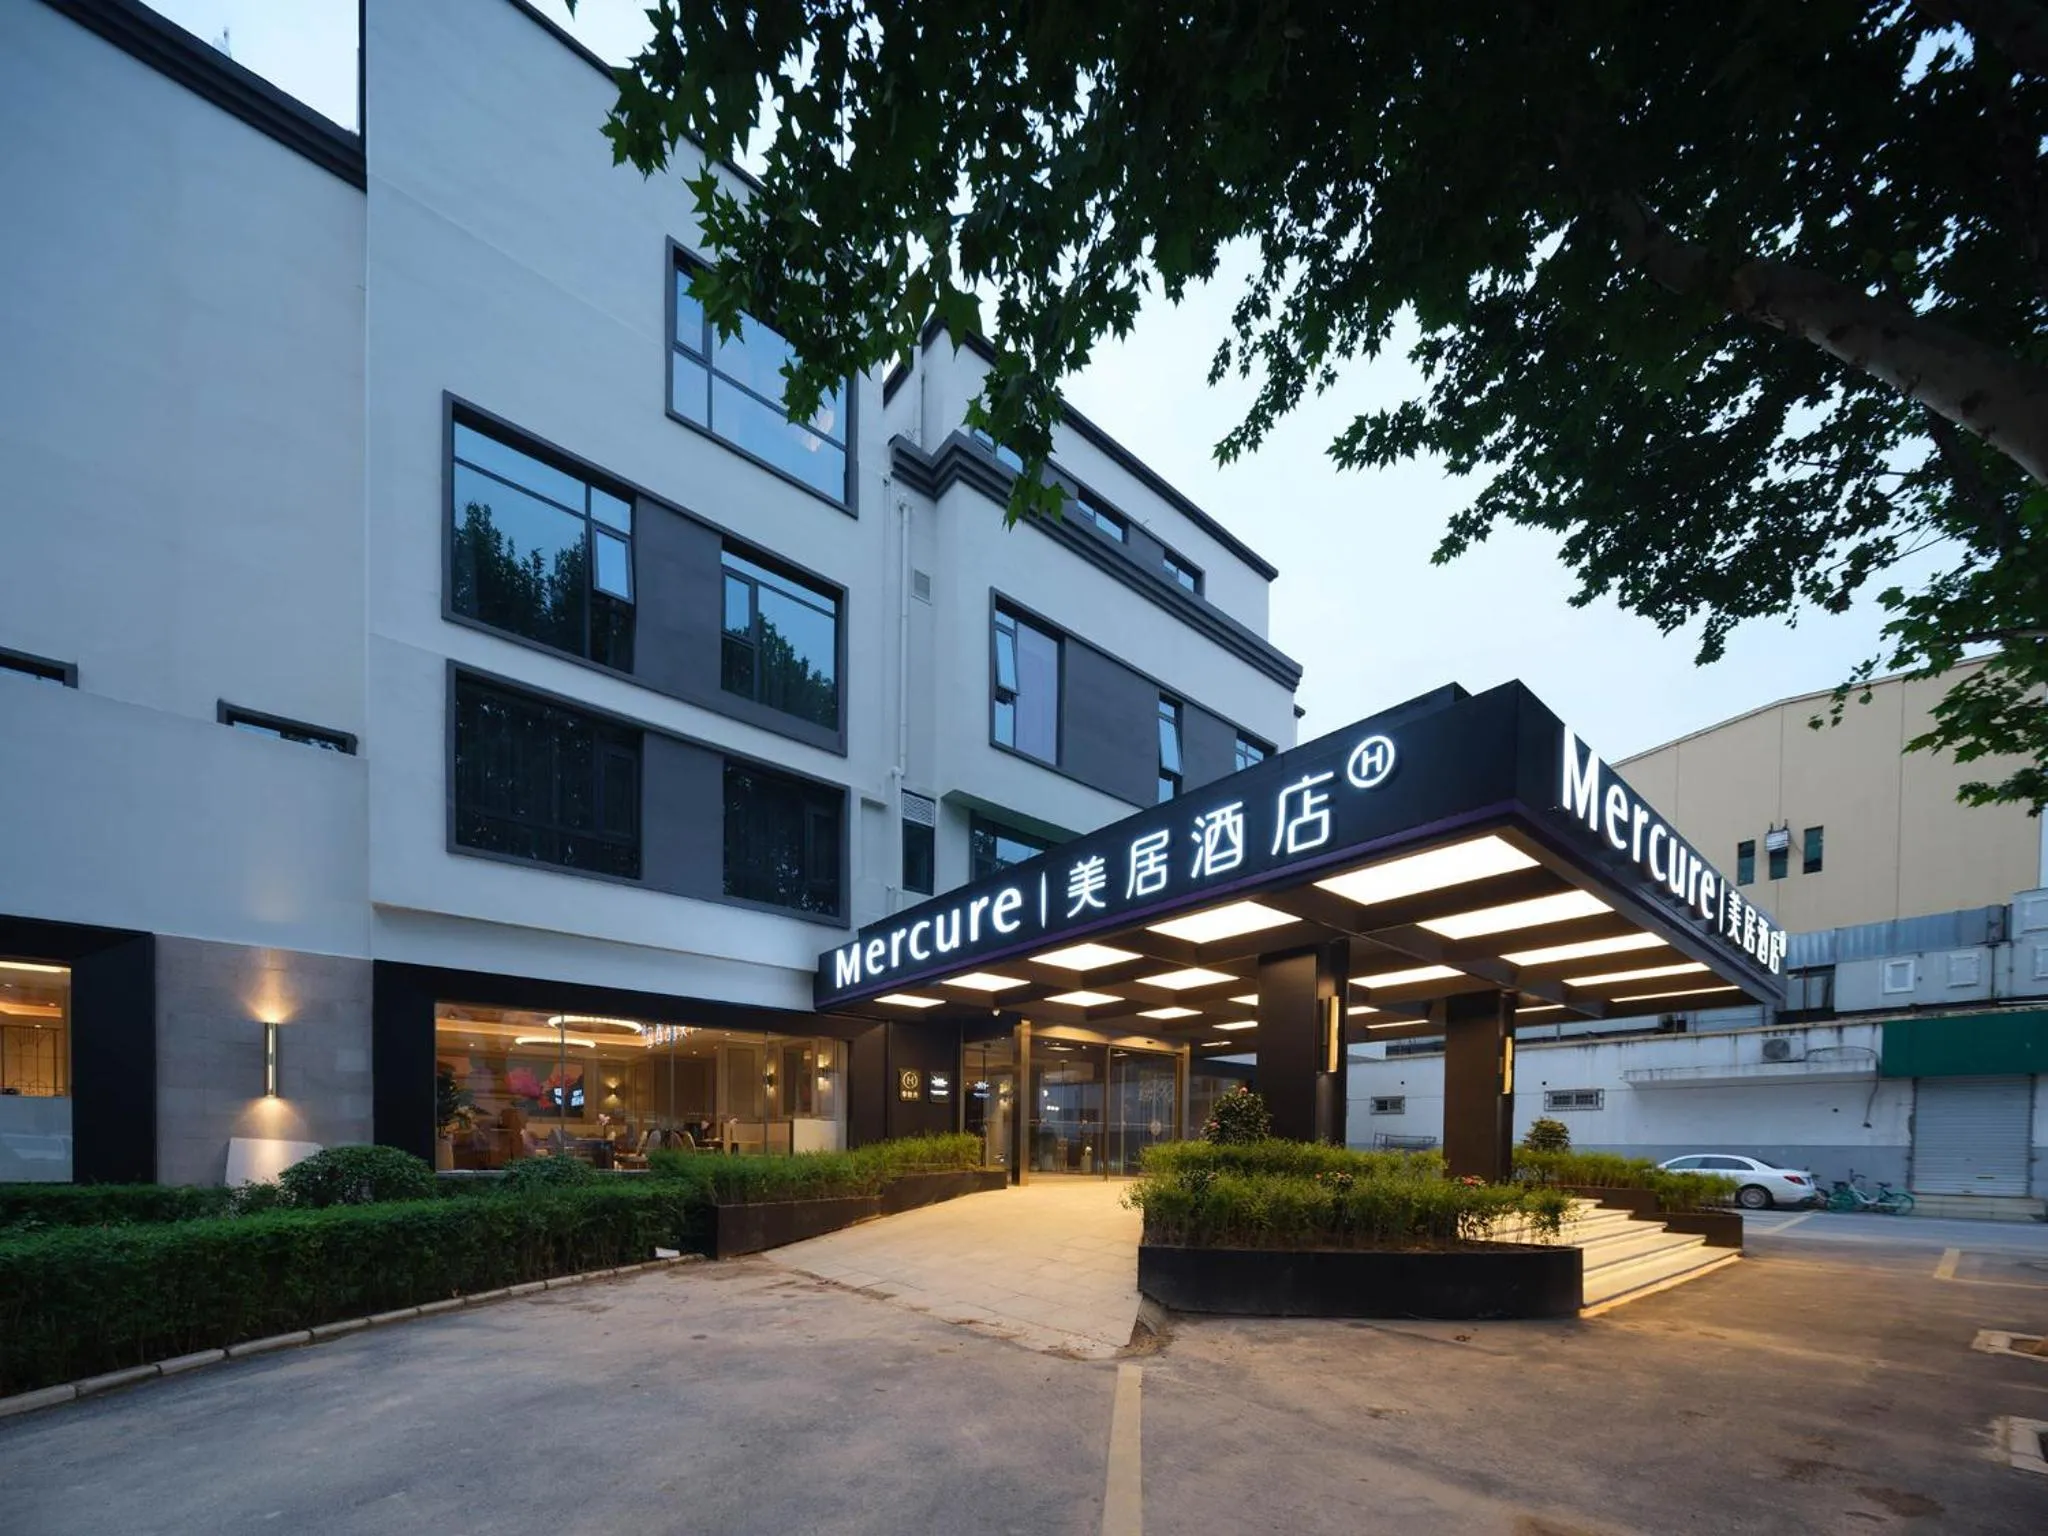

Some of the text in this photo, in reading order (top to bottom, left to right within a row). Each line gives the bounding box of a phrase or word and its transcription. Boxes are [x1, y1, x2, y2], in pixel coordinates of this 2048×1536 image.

[836, 886, 1021, 989] Mercure
[1066, 771, 1336, 918] 美居酒店
[1561, 726, 1781, 975] Mercure 美居酒店
